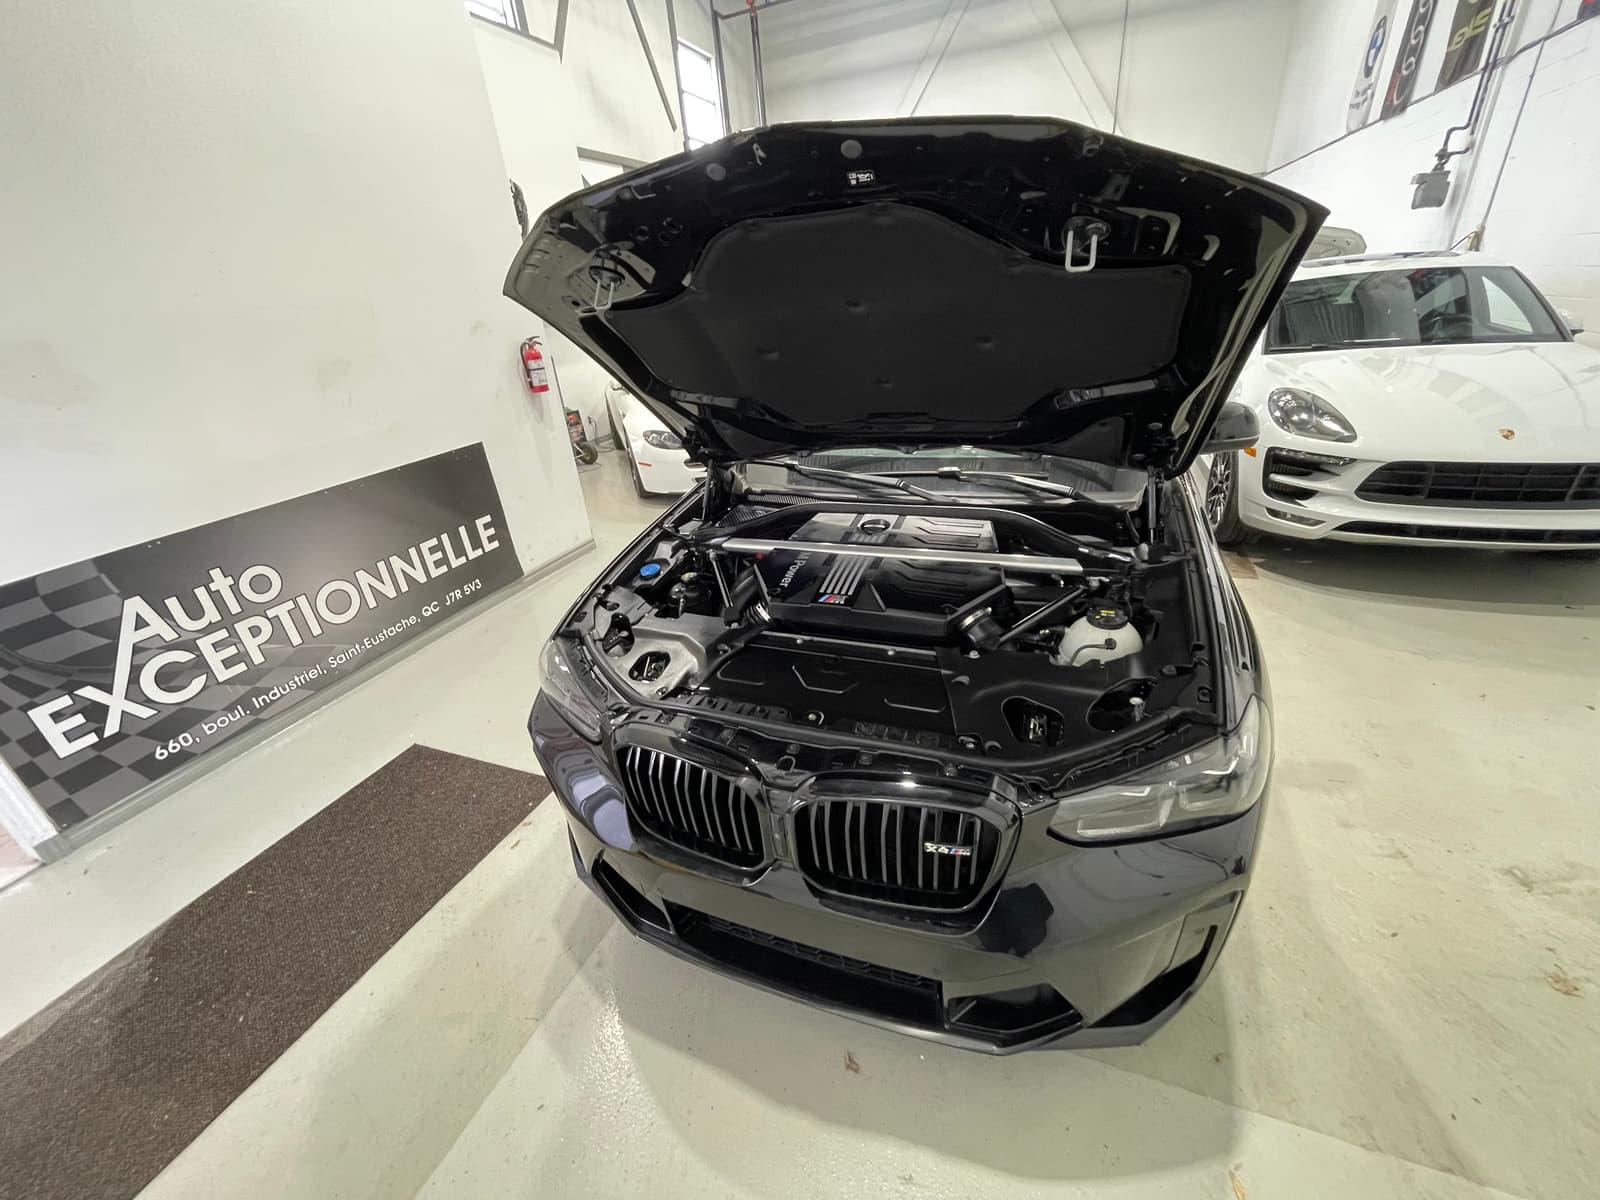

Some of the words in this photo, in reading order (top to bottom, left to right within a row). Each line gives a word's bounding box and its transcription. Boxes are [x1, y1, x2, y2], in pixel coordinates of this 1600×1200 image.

[27, 514, 500, 759] EXCEPTIONNELLE
[115, 565, 283, 648] Auto
[780, 560, 806, 588] Power
[155, 733, 200, 760] 660,
[202, 705, 251, 735] boul.
[252, 664, 327, 709] Industriel,
[328, 615, 421, 668] Saint-Eustache,
[422, 601, 440, 617] QC
[445, 589, 463, 606] J7R
[464, 578, 482, 595] 5V3
